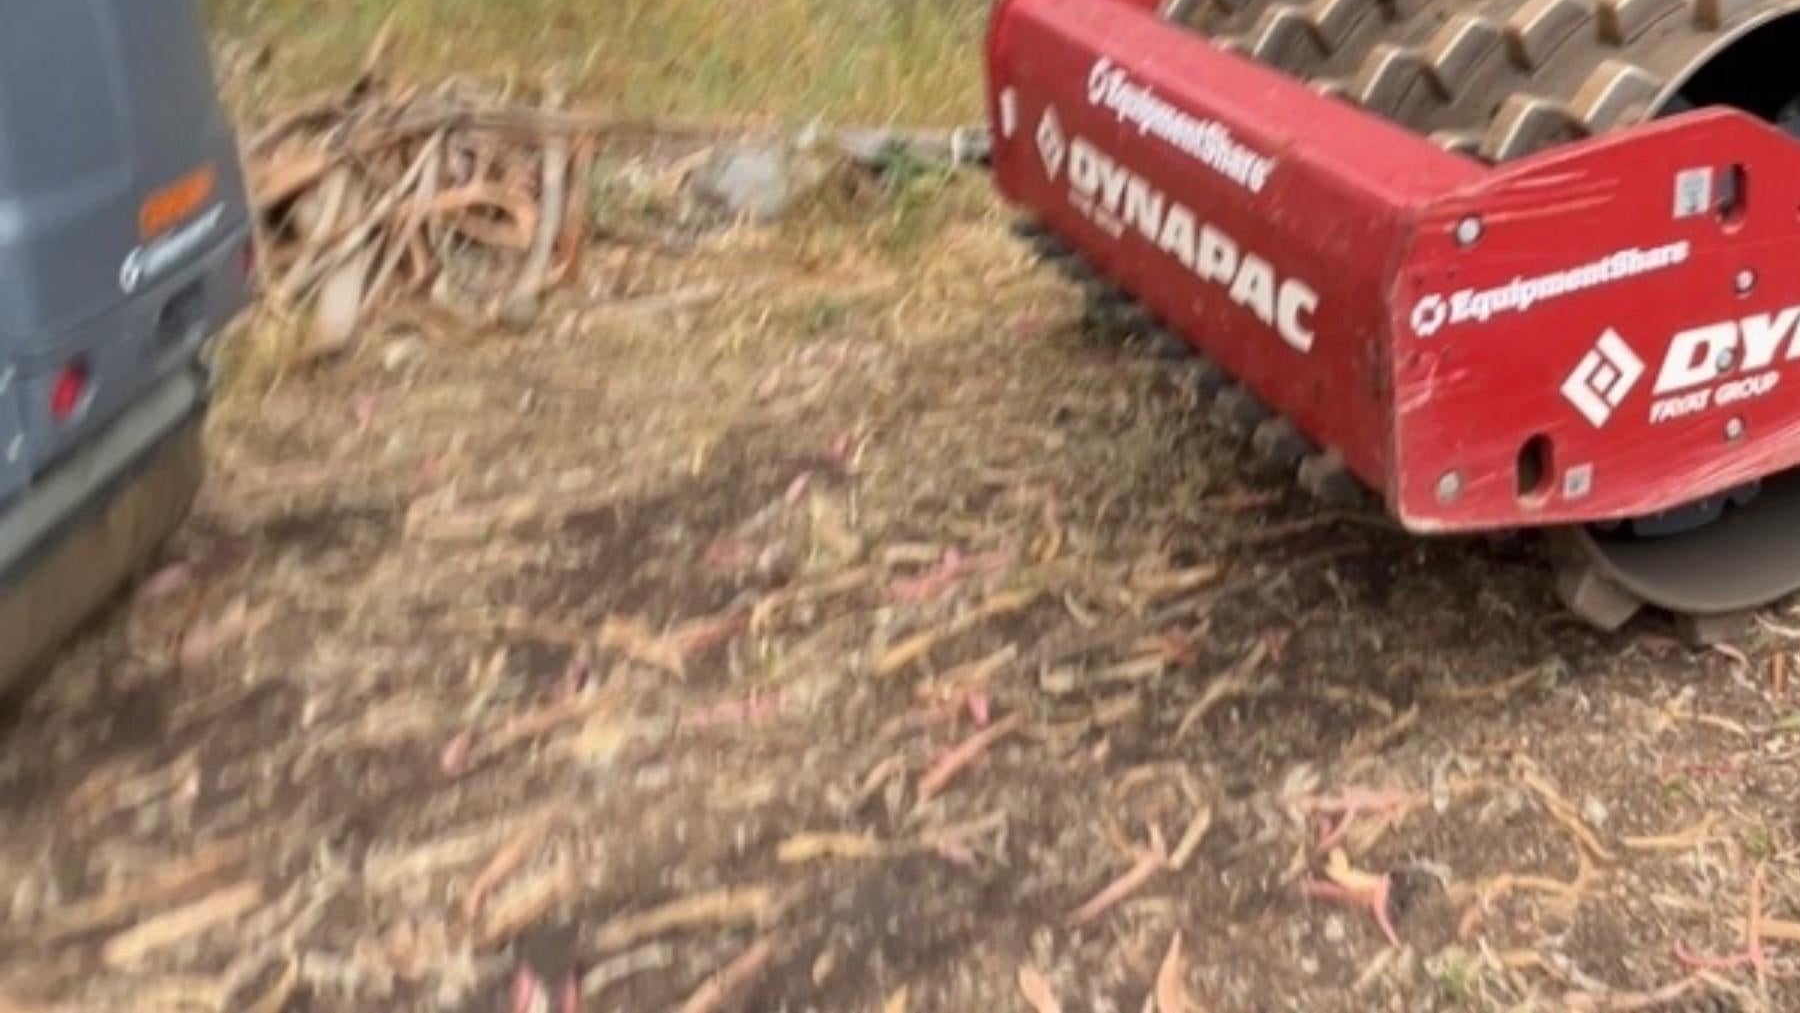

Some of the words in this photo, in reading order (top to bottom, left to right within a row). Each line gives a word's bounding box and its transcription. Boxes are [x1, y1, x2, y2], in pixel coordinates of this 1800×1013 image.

[1068, 135, 1319, 354] DYNAPAC
[1449, 239, 1691, 324] EquipmentShare
[1713, 369, 1781, 407] GROUP
